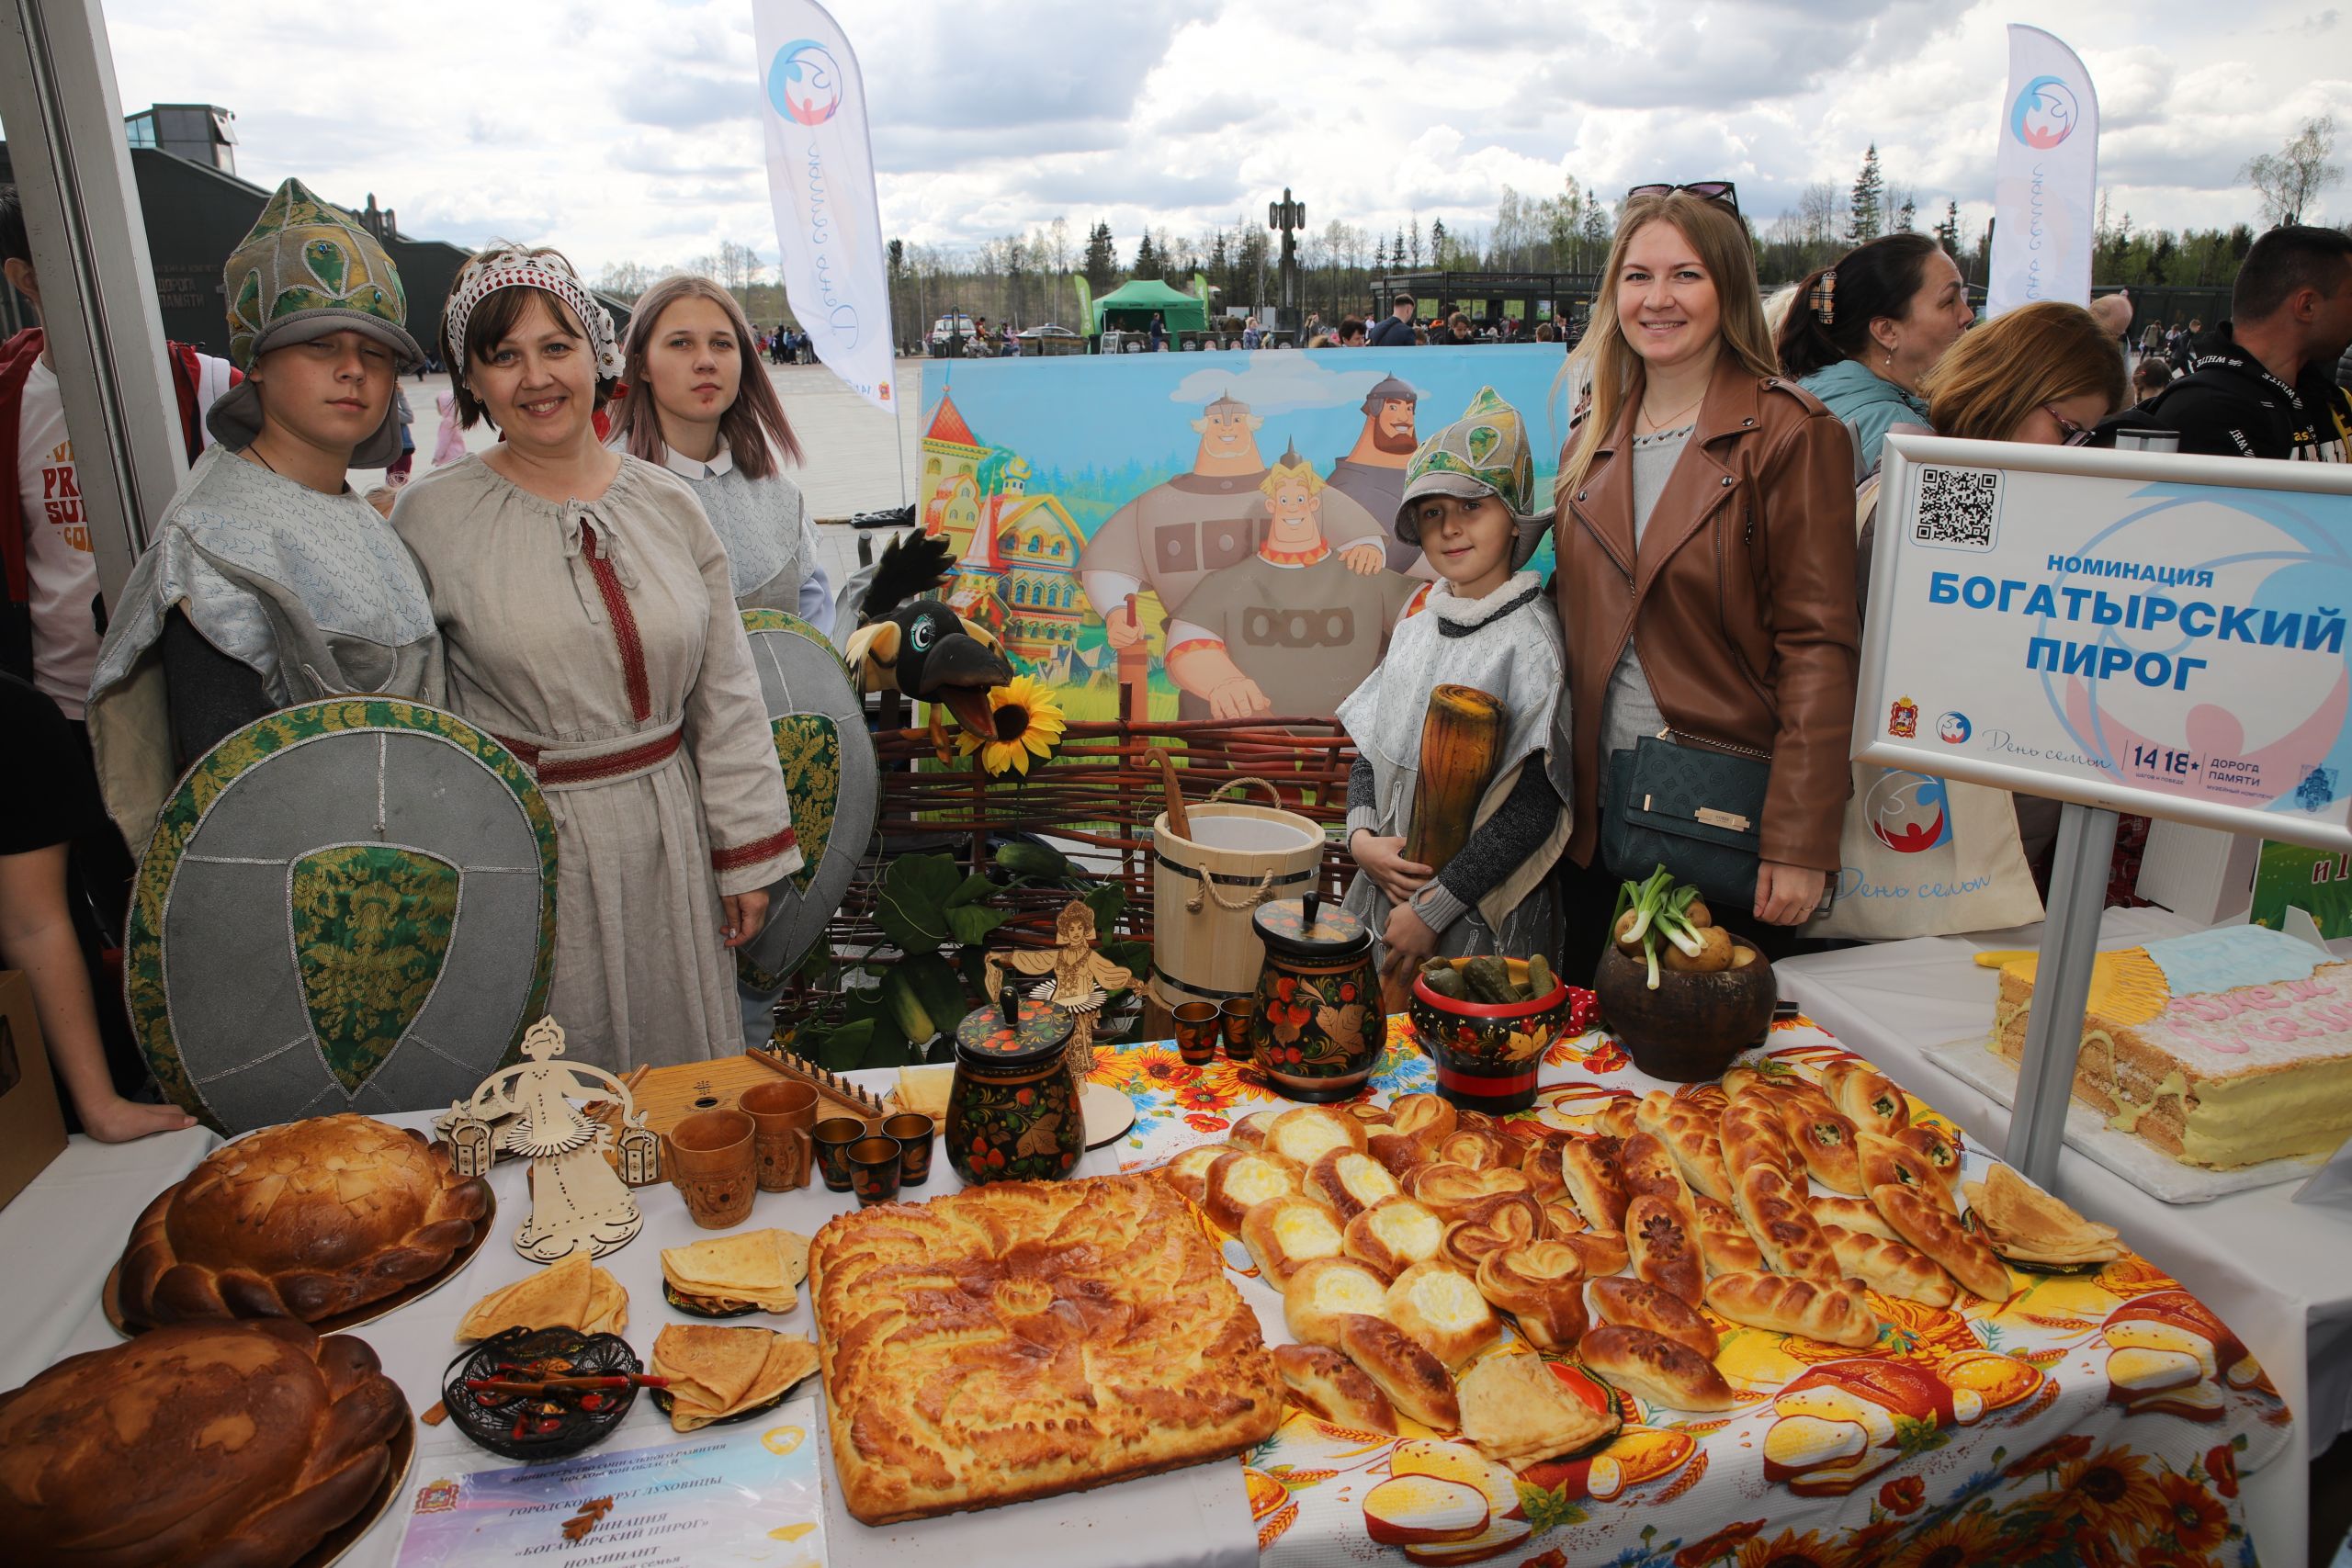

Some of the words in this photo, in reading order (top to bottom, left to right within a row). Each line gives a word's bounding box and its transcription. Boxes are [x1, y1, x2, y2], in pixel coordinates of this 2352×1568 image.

[2261, 372, 2296, 399] WHITE
[2047, 555, 2214, 588] НОМИНАЦИЯ
[1929, 571, 2346, 653] БОГАТЫРСКИЙ
[2026, 637, 2208, 691] ПИРОГ
[1982, 728, 2039, 756] День
[2045, 750, 2111, 769] семьи
[2209, 771, 2260, 787] ПАМЯТИ
[2211, 758, 2260, 773] ДОРОГА
[1836, 866, 1910, 901] День
[511, 1465, 595, 1483] МИНИСТЕРСТВО
[675, 1443, 727, 1457] РАЗВИТИЯ
[643, 1476, 723, 1495] ЛУХОВИЦЫ
[648, 1518, 708, 1537] ПИРОГ»
[563, 1546, 662, 1568] НОМИНАНТ
